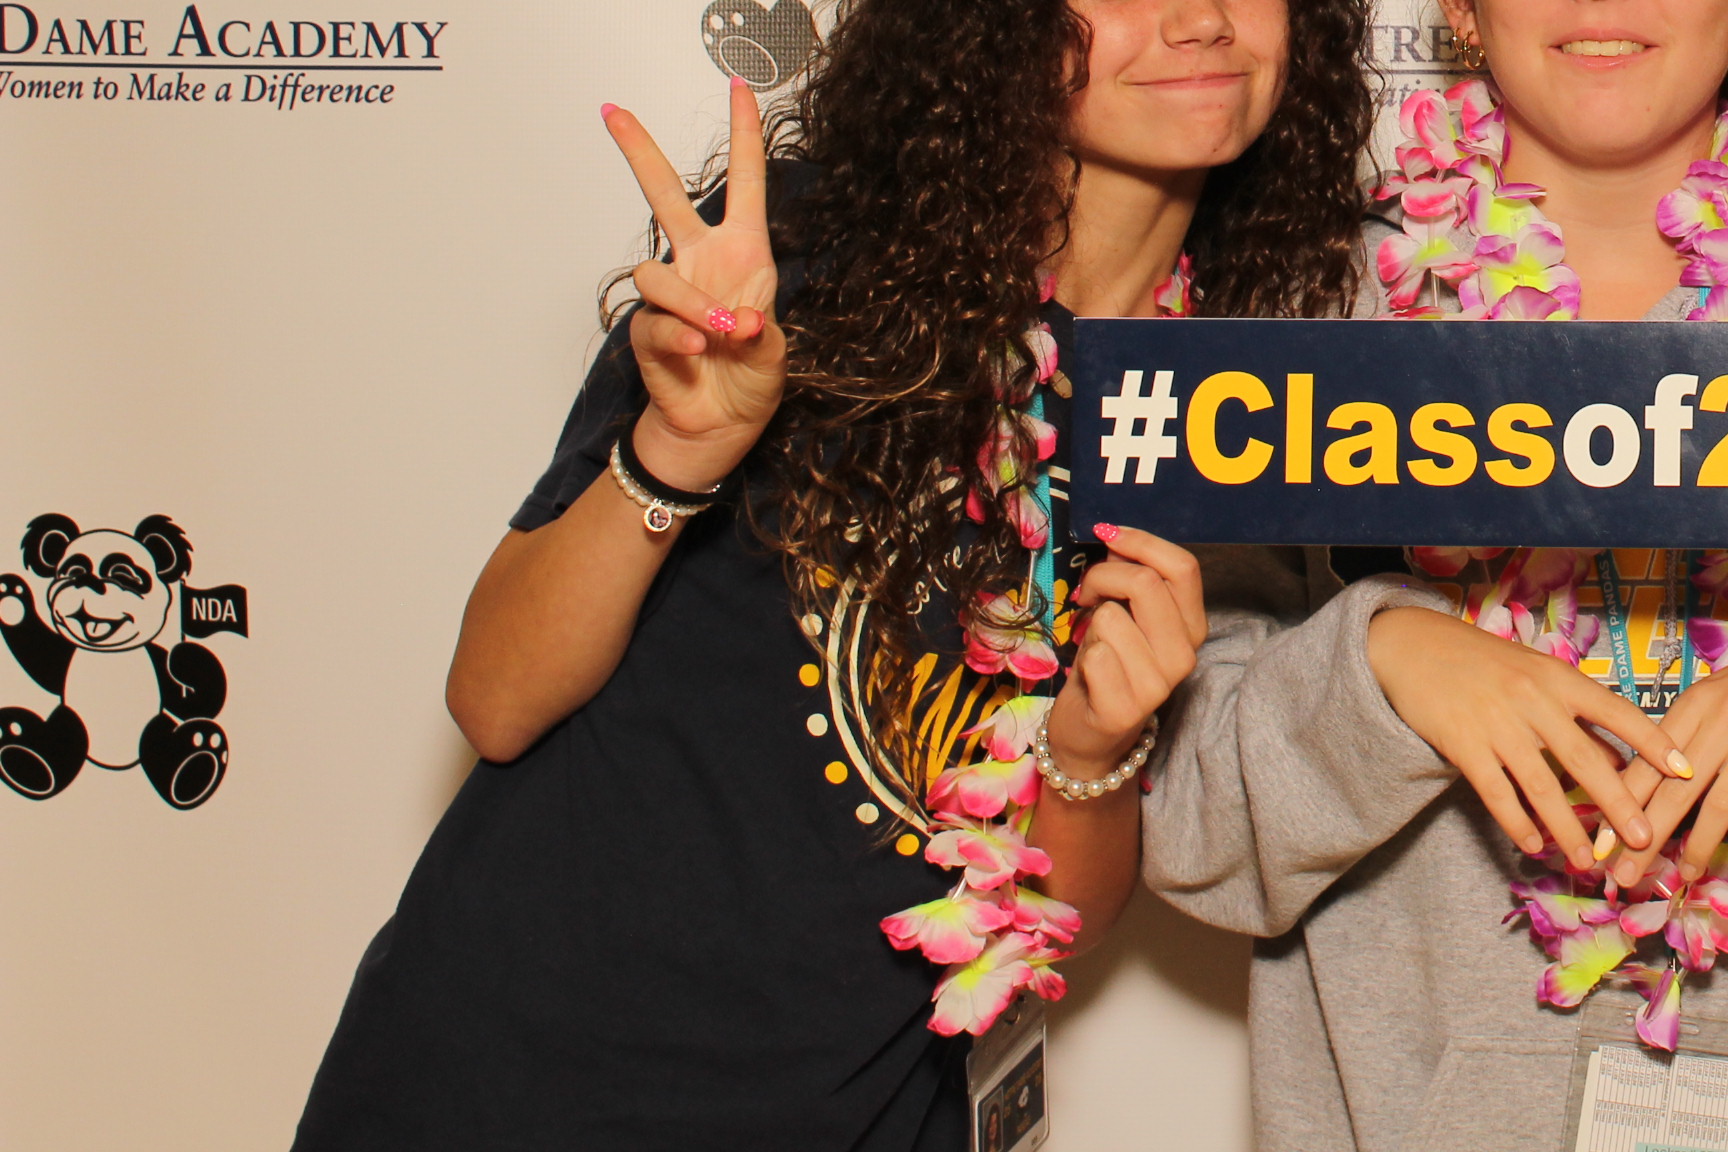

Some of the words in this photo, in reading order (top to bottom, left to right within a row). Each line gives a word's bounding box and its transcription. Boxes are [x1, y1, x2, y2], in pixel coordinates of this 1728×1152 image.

[167, 4, 448, 58] ACADEMY
[1363, 25, 1460, 63] TRE
[93, 76, 118, 100] to
[126, 72, 206, 101] Make
[215, 83, 232, 102] a
[241, 72, 394, 111] Difference
[192, 597, 237, 622] NDA
[1600, 559, 1621, 627] PANDAS
[1612, 630, 1631, 679] DAME
